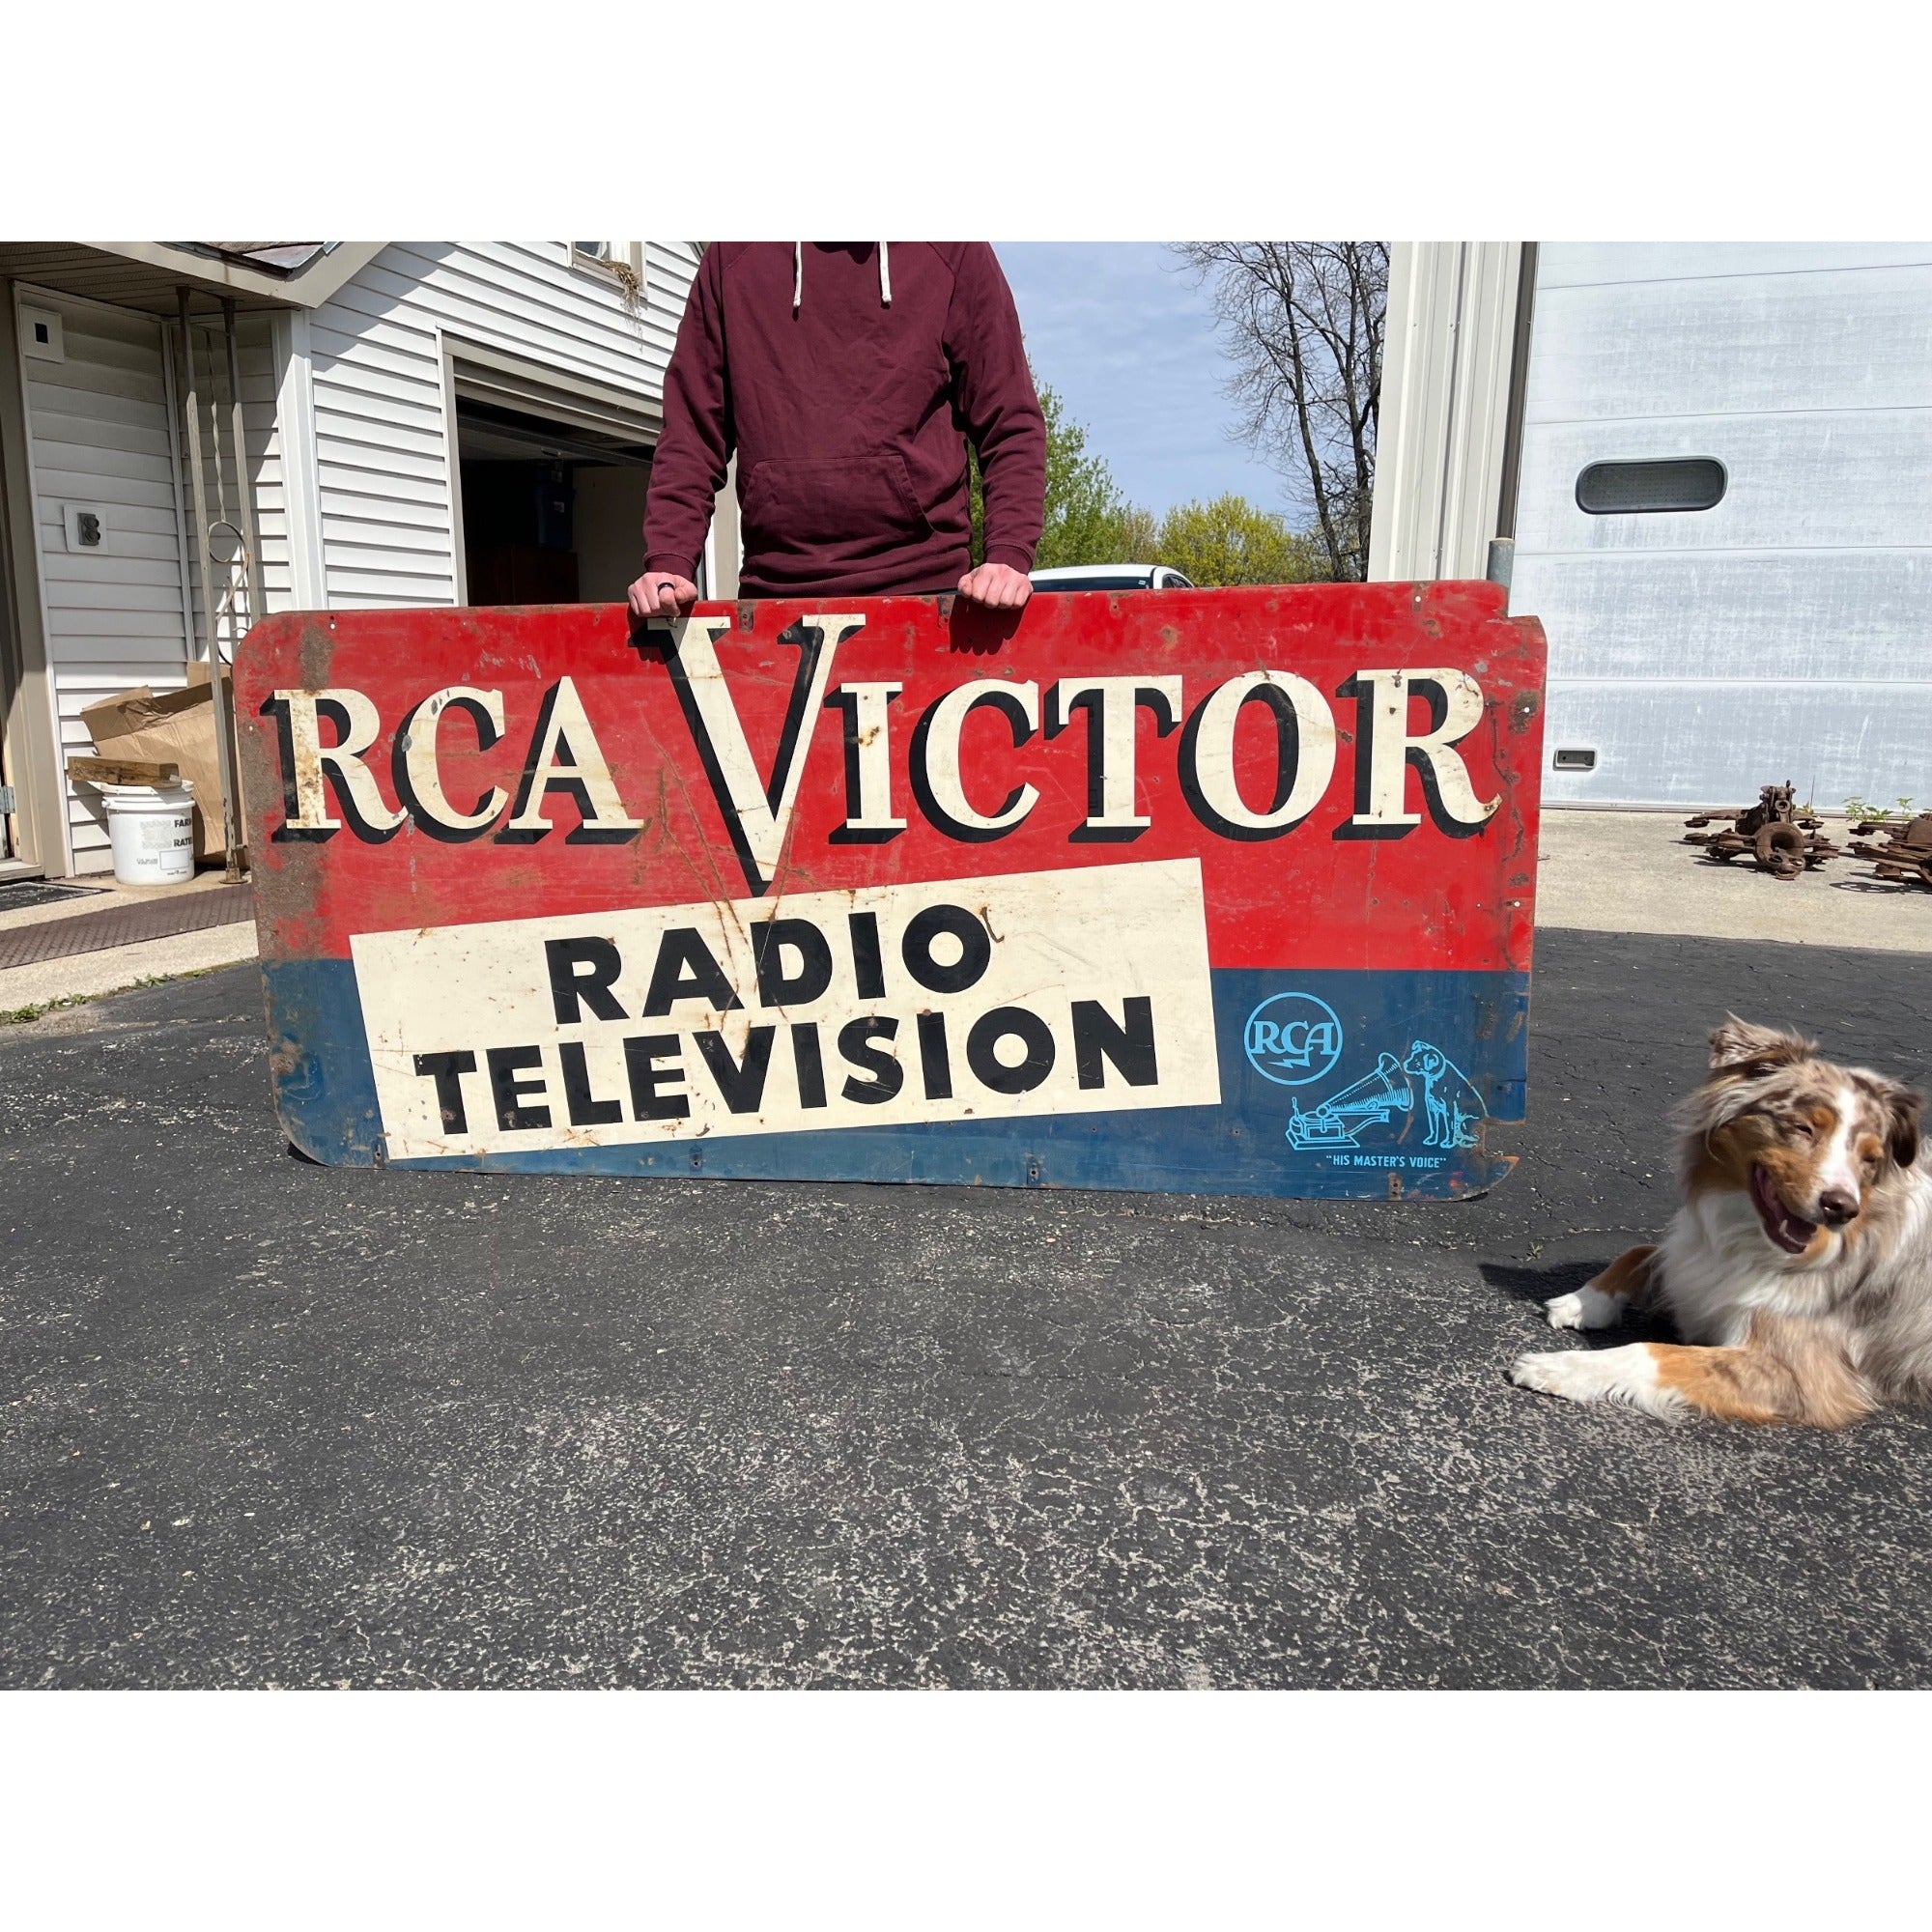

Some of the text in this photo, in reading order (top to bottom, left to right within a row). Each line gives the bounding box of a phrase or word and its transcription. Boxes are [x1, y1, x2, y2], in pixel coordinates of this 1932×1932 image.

[259, 612, 1503, 898] RCA VICTOR
[544, 904, 991, 1025] RADIO
[412, 996, 1159, 1136] TELEVISION
[1254, 1020, 1336, 1058] RCA
[1353, 1155, 1406, 1168] MASTER'S
